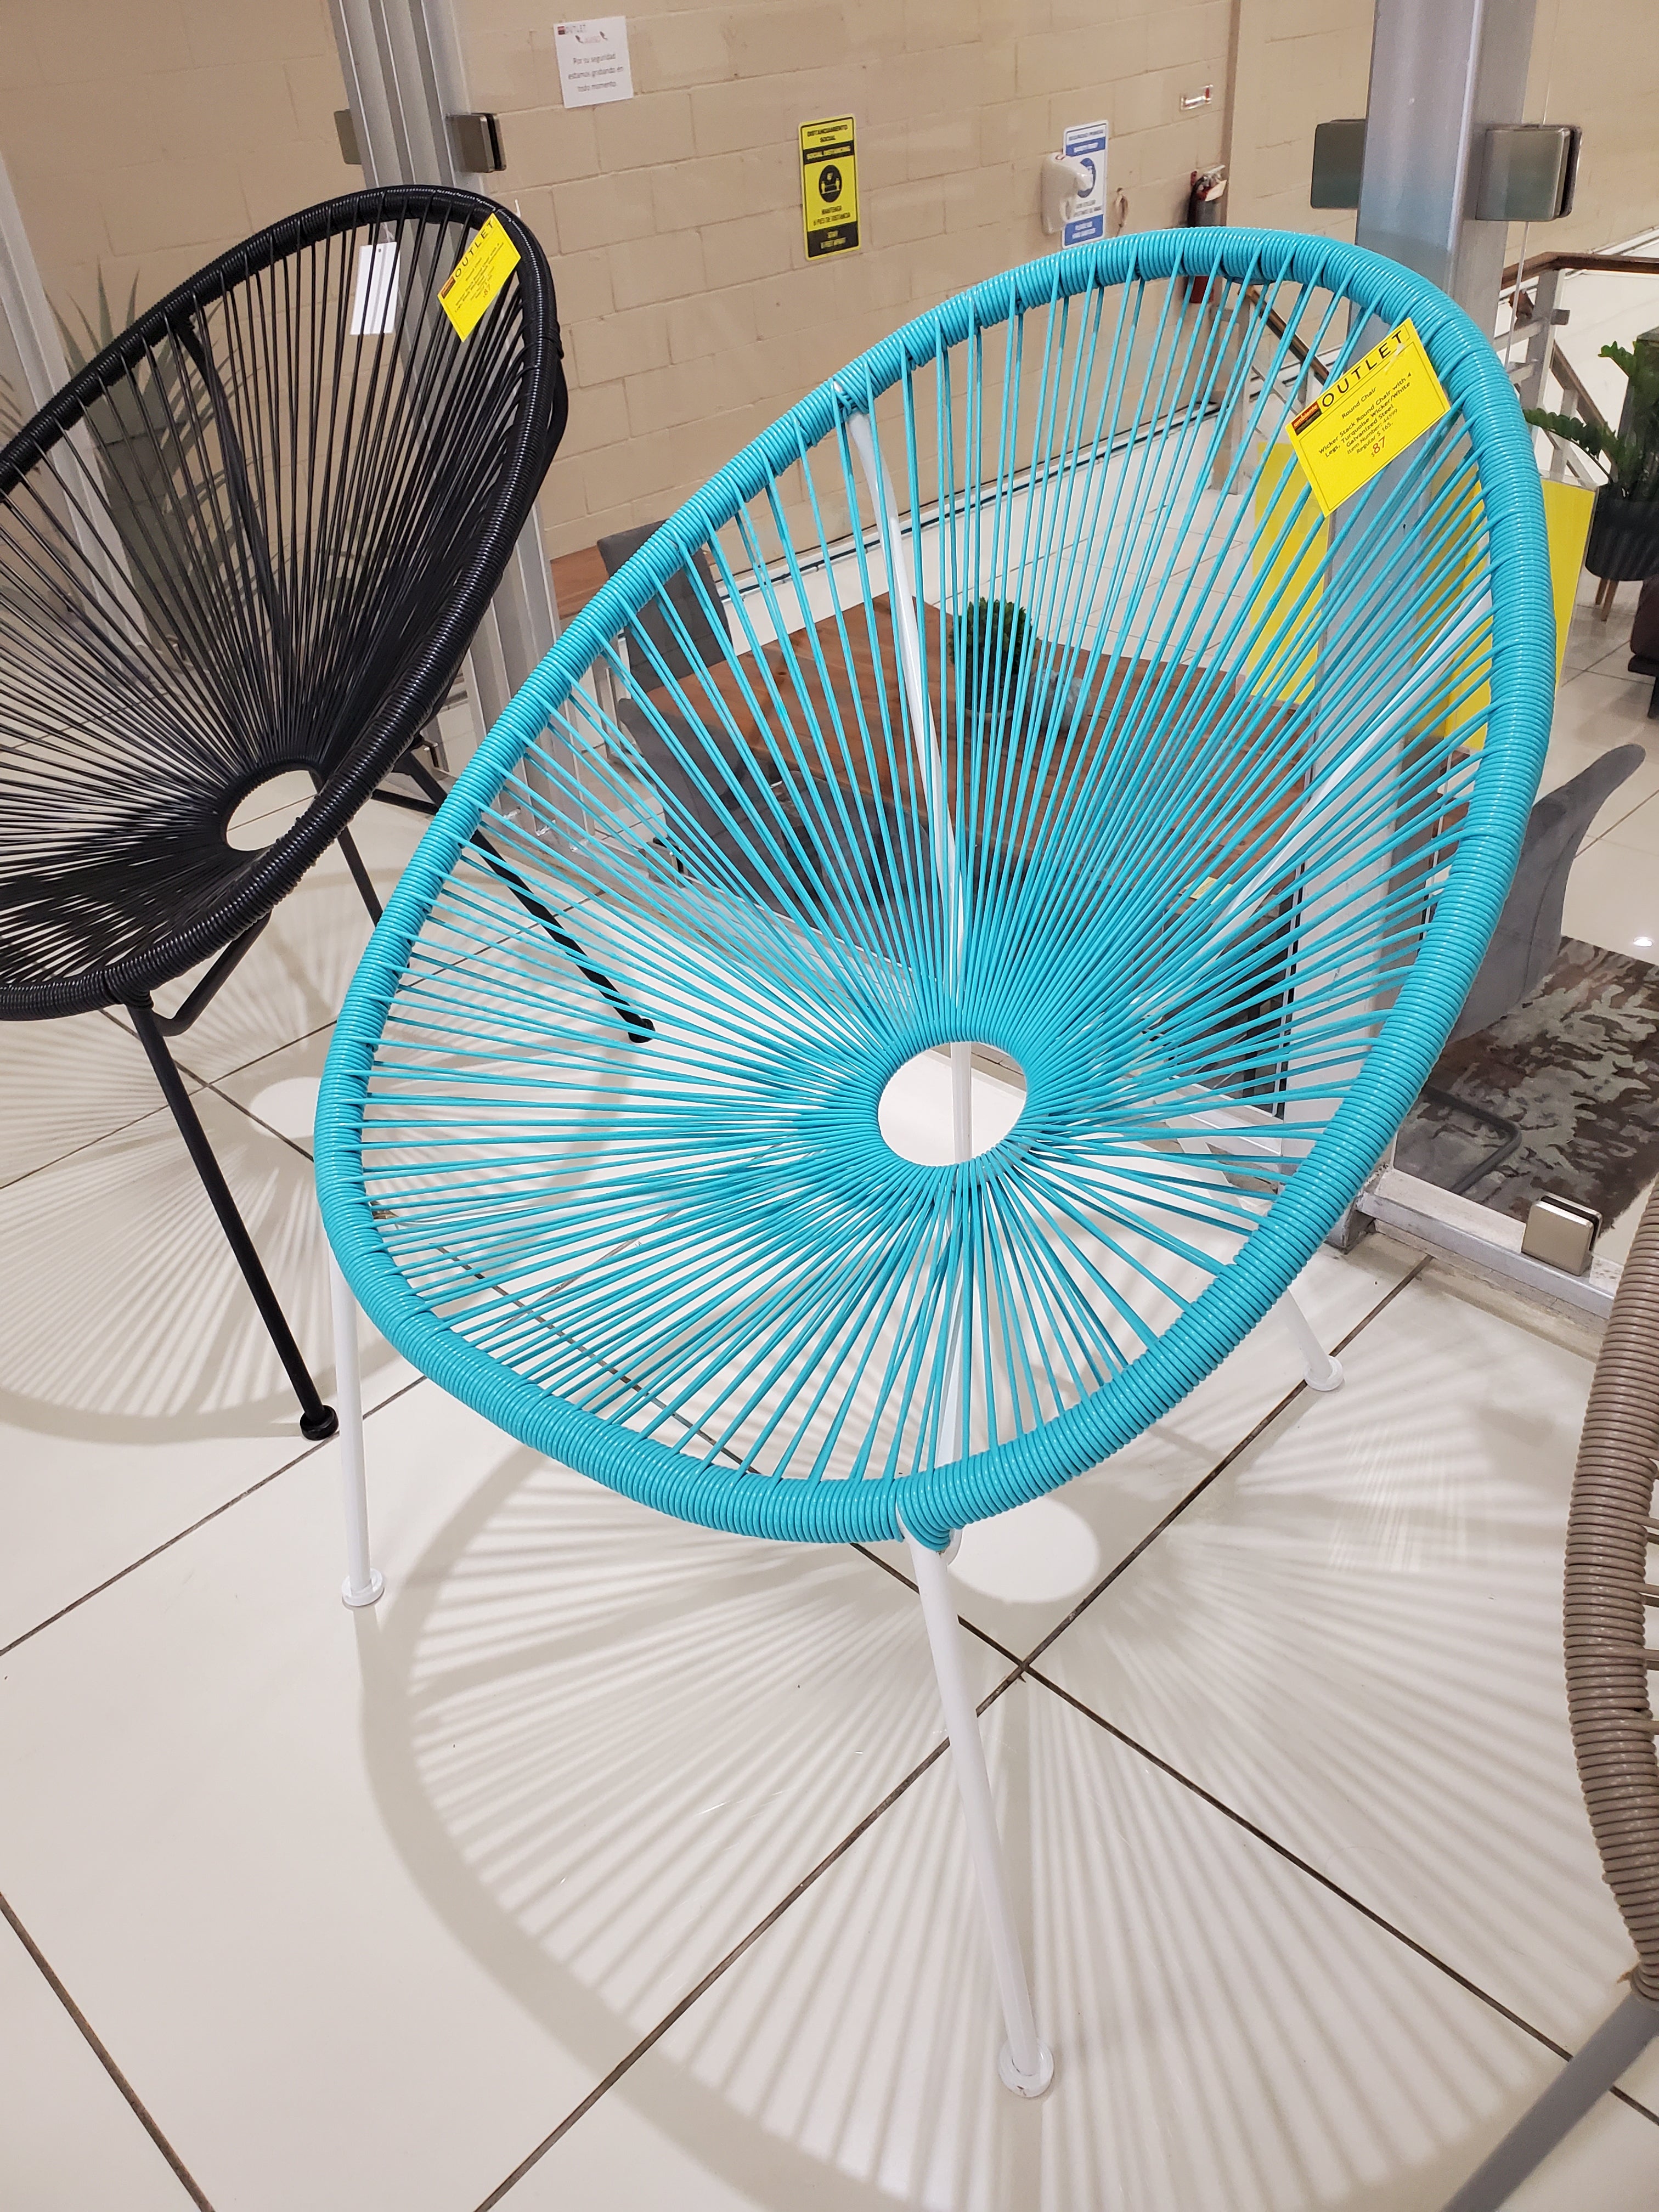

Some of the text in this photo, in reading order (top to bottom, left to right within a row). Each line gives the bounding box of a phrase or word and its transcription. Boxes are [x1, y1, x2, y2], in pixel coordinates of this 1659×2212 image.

[591, 53, 616, 63] seguridad
[455, 221, 493, 278] OUTLET
[1322, 330, 1402, 407] OUTLET
[1294, 404, 1317, 427] ambiente
[1319, 436, 1339, 454] Wicker
[1339, 421, 1356, 437] Stack
[1356, 404, 1374, 422] Round
[1376, 390, 1391, 405] Chair
[1392, 378, 1406, 390] with
[1325, 382, 1410, 457] Legs, Turquoise Wicker/White
[1341, 387, 1376, 419] Round Chair
[1346, 404, 1394, 448] Galvanized Steel
[1356, 436, 1376, 454] Regular
[1347, 443, 1359, 455] Item
